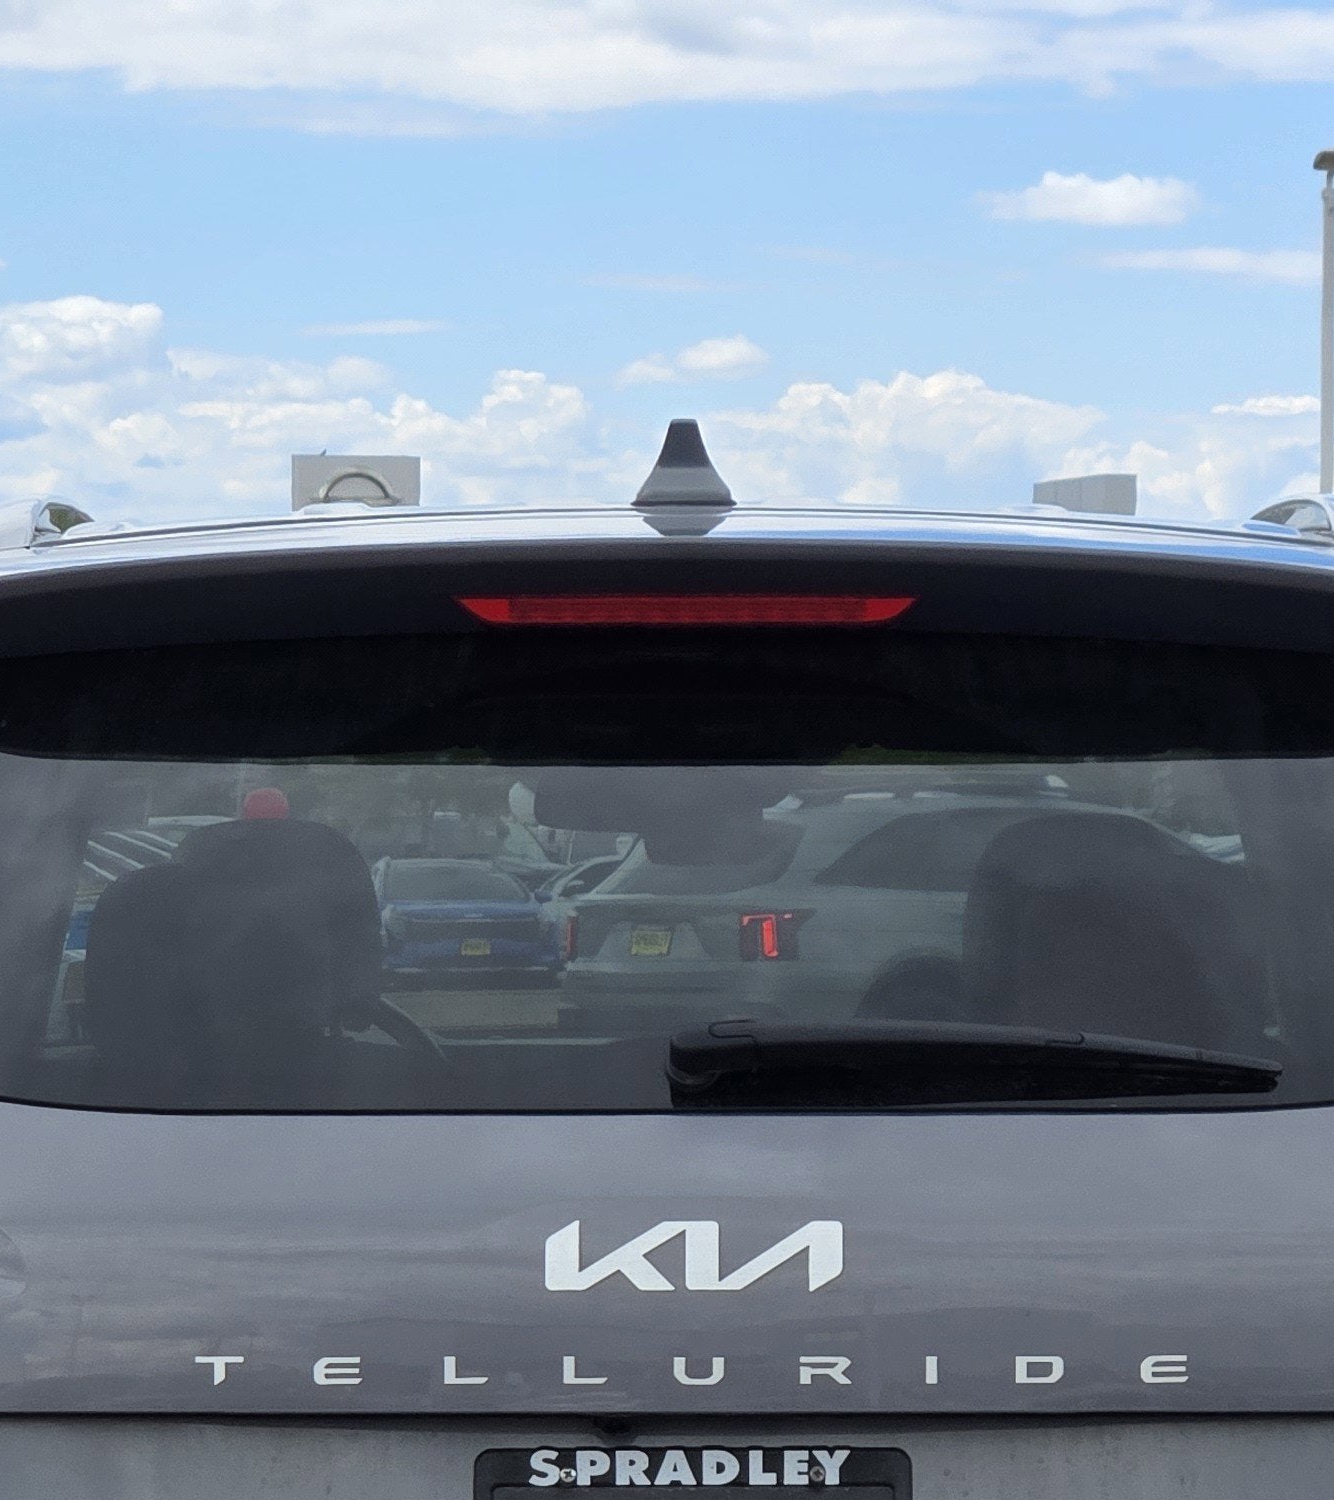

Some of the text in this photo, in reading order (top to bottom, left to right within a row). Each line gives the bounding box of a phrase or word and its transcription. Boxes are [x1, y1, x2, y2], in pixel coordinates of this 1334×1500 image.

[544, 1219, 844, 1293] KIA
[194, 1354, 1190, 1386] TELLURIDE
[528, 1449, 851, 1487] SPRADLEY
